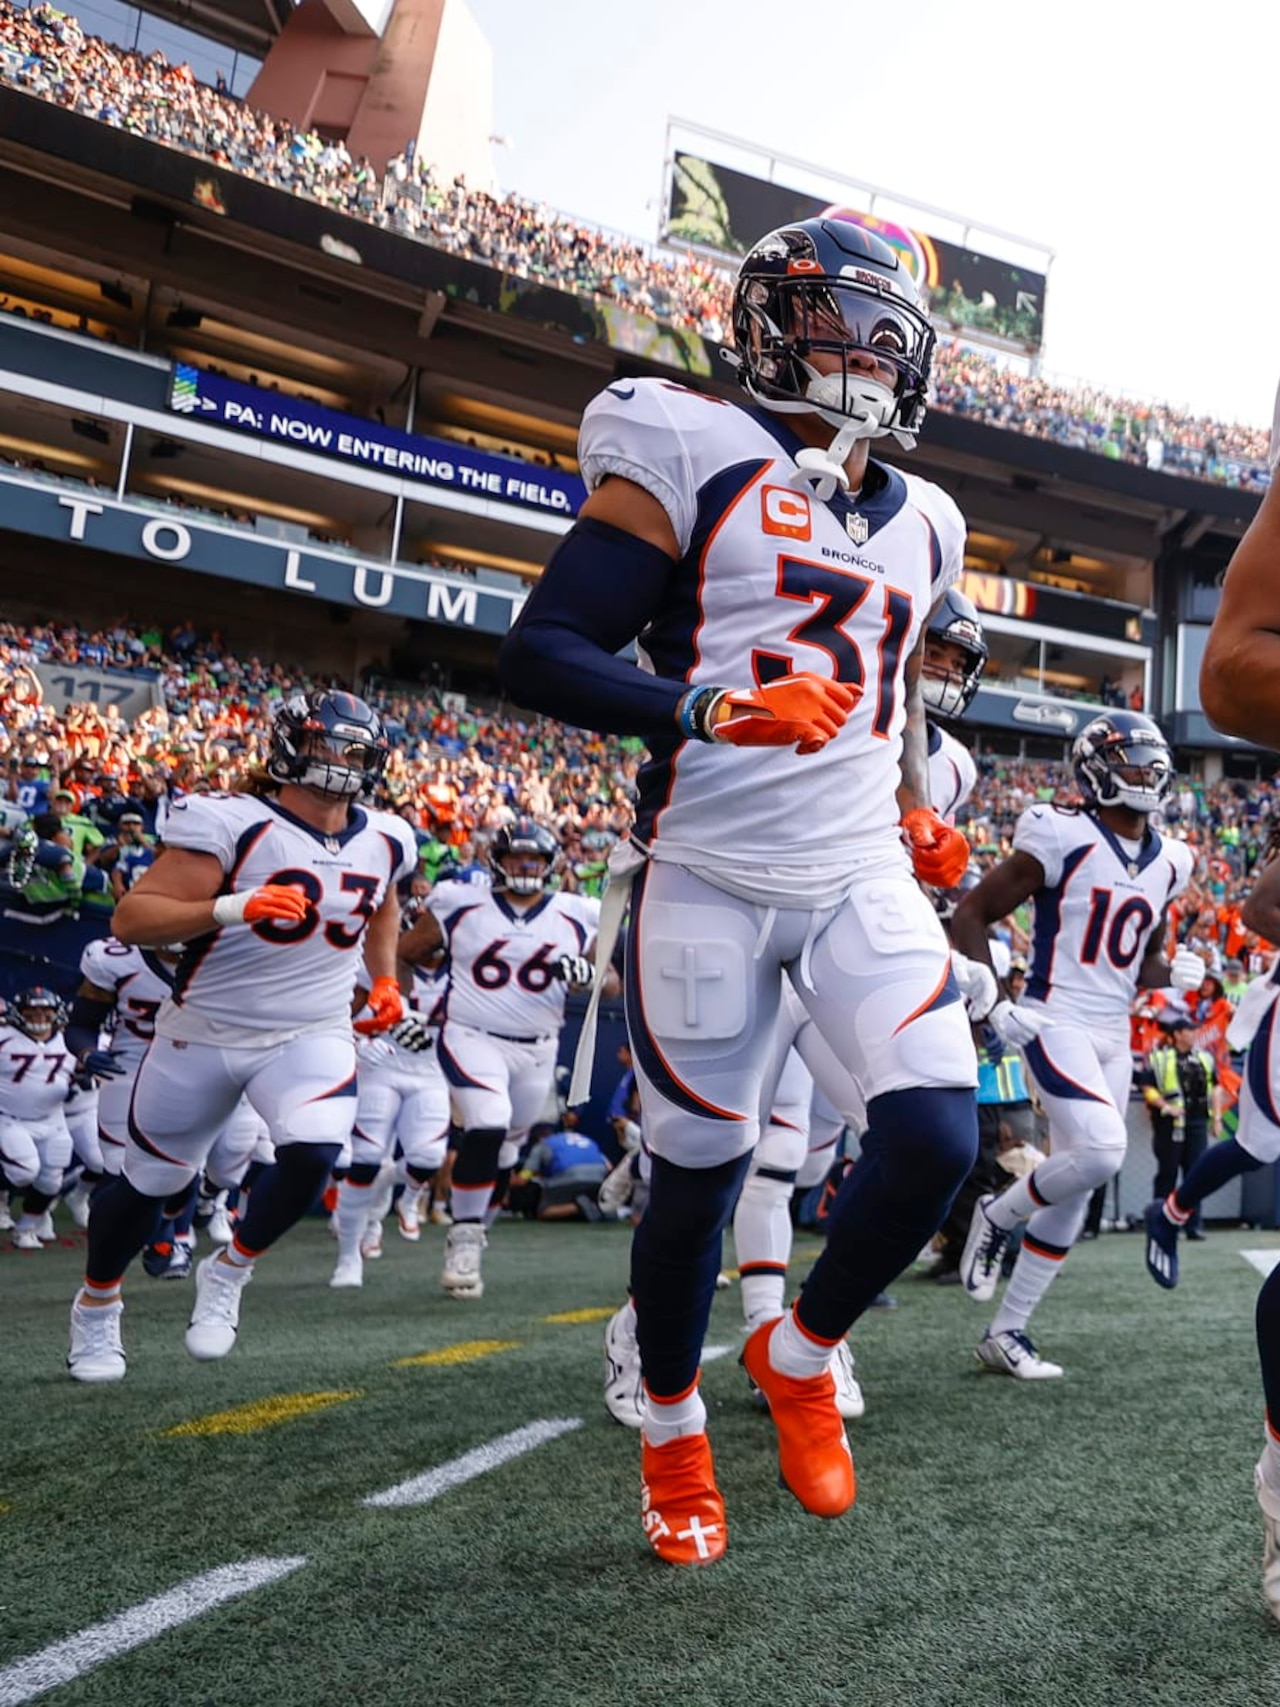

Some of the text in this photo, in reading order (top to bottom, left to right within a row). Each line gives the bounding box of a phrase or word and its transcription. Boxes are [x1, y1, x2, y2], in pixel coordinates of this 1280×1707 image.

[224, 401, 572, 511] PA: NOW ENTERING THE FIELD.
[764, 488, 808, 527] C
[58, 496, 525, 628] TO LUM
[821, 547, 885, 574] BRONCOS
[751, 553, 913, 740] 31
[51, 675, 135, 705] 117
[1079, 886, 1153, 969] 10
[471, 939, 557, 993] 66
[9, 1053, 67, 1084] 77
